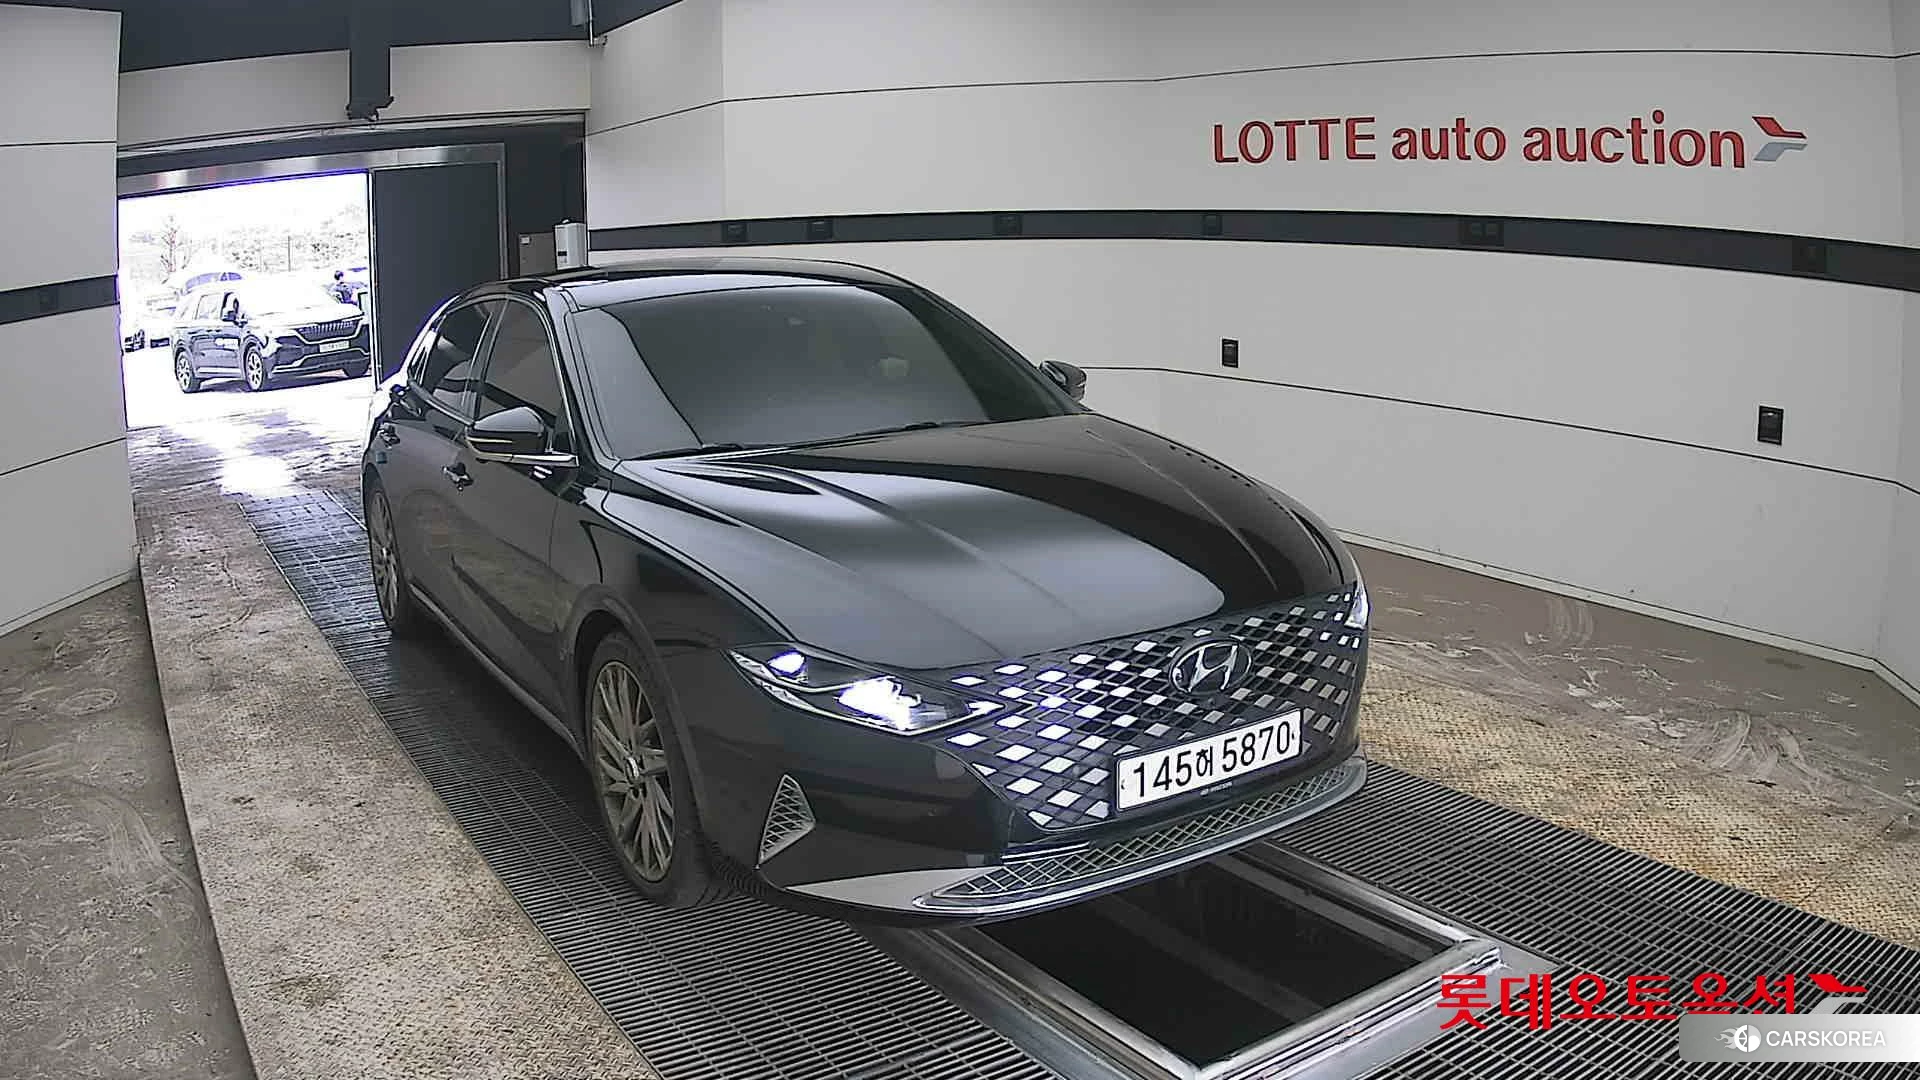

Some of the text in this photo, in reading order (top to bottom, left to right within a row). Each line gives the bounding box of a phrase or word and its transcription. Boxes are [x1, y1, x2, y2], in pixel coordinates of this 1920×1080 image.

[1214, 109, 1745, 168] LOTTE auto auction
[1133, 721, 1290, 798] 145허 5870
